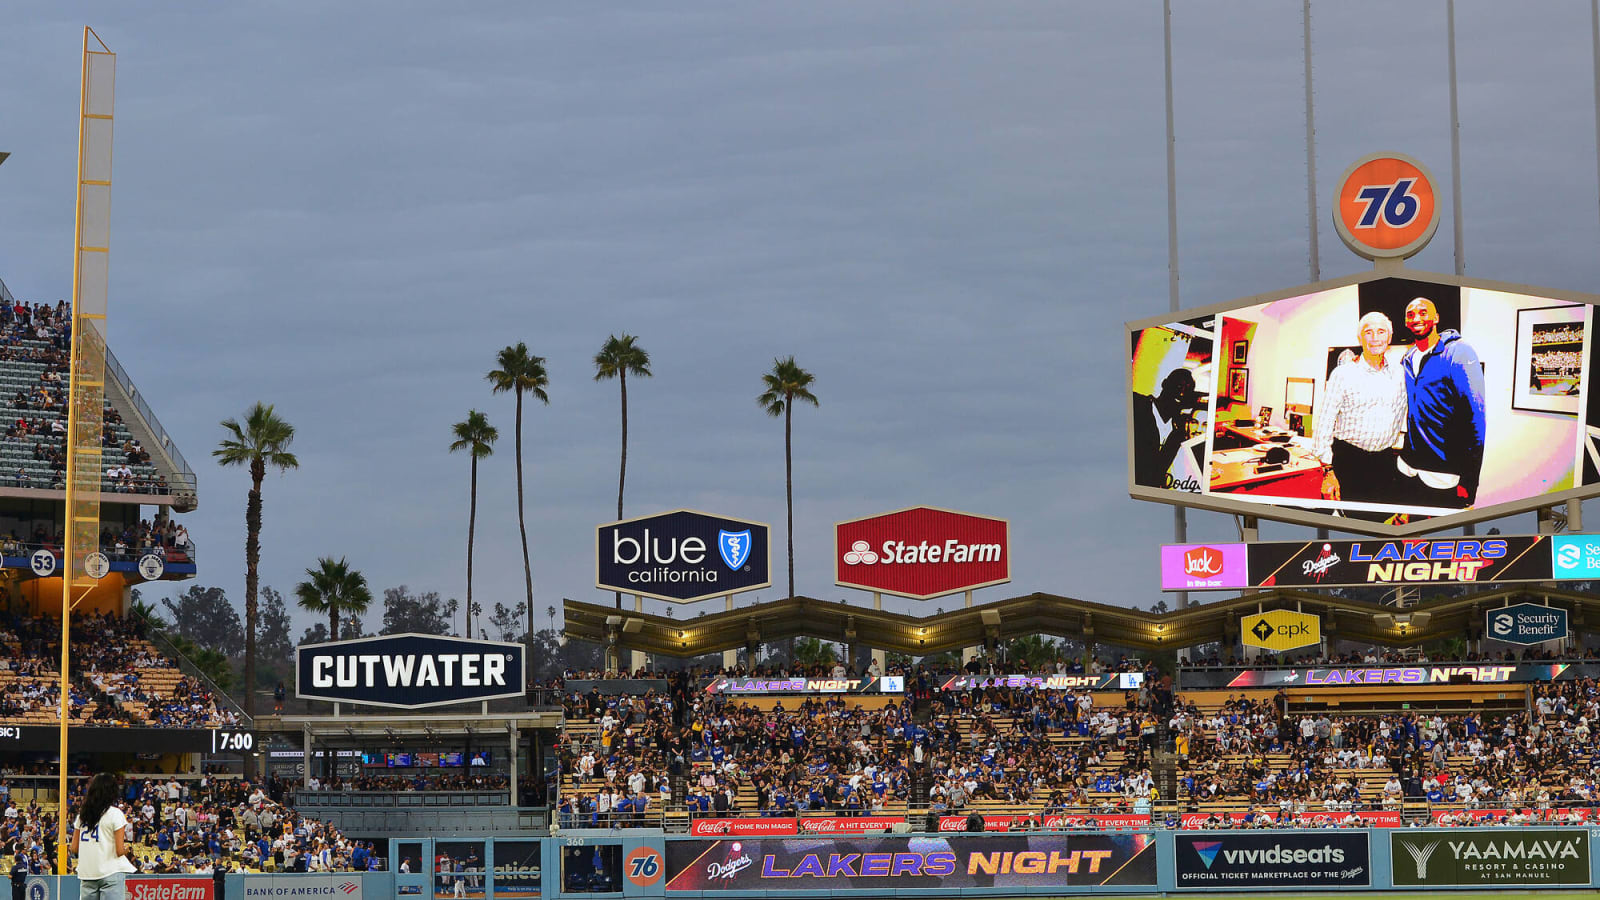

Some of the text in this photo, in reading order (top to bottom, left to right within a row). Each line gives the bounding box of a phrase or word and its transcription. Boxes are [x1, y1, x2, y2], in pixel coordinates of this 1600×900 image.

[1353, 177, 1418, 229] 76
[614, 528, 706, 564] blue
[1349, 540, 1508, 562] LAKERS
[34, 555, 53, 570] 53
[1185, 549, 1222, 574] Jack
[1302, 552, 1342, 575] Dodgers
[628, 568, 718, 583] california
[1366, 561, 1485, 582] NIGHT
[1517, 613, 1560, 626] Security
[1277, 621, 1310, 638] cpk
[1518, 625, 1556, 635] Benefit
[731, 680, 804, 690] LAKERS
[807, 679, 861, 690] NIGHT
[1046, 676, 1101, 687] NIGHT
[1305, 669, 1421, 684] LAKERS
[220, 733, 252, 749] 7:00
[80, 823, 99, 842] 24
[566, 838, 584, 846] 360
[1223, 844, 1345, 864] vividseats
[630, 854, 659, 878] 76
[707, 850, 1113, 880] Dodgers LAKERS NIGHT
[1464, 863, 1507, 871] RESORT
[1182, 872, 1219, 880] OFFICIAL
[1251, 871, 1308, 879] MARKETPLACE
[247, 886, 336, 896] BANK OF AMERICA
